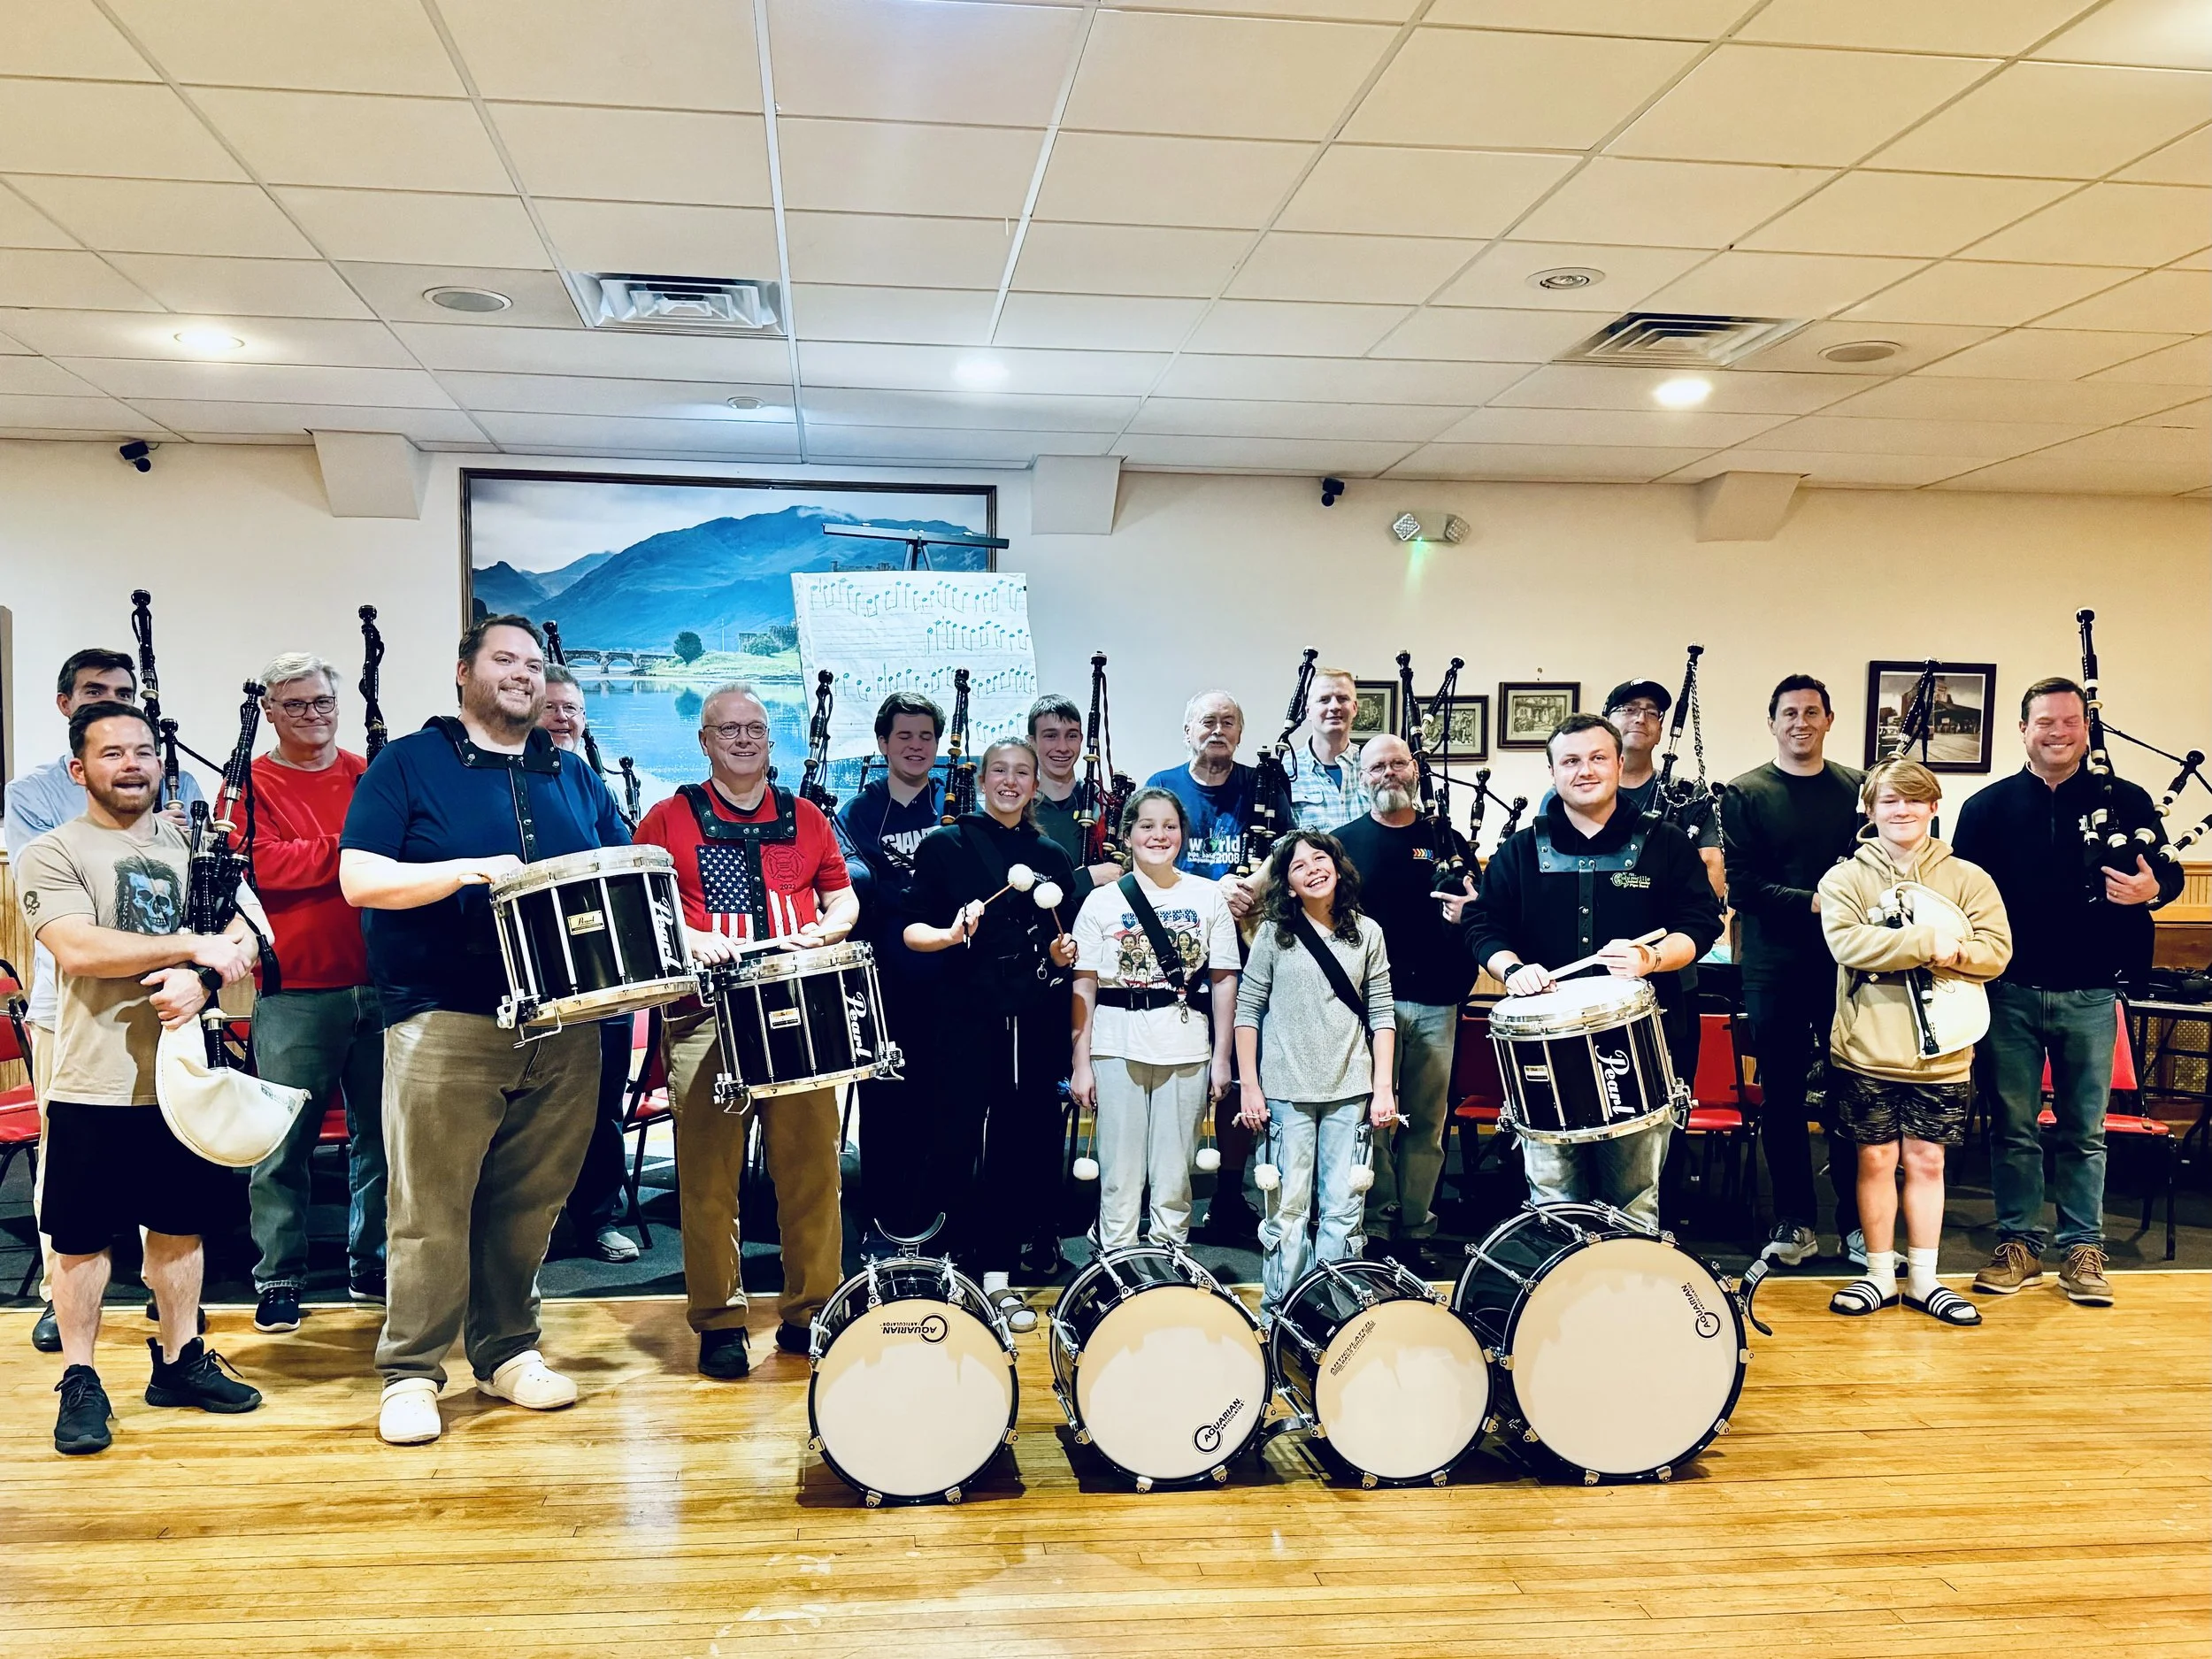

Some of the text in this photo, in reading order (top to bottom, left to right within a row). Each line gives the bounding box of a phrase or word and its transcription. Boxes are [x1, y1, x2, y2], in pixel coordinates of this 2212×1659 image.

[1215, 851, 1240, 864] 2008
[844, 991, 872, 1058] Pearl
[1594, 1045, 1636, 1115] Pearl
[1681, 1285, 1711, 1328] AQUARIAN
[1204, 1398, 1240, 1442] AQUARIAN
